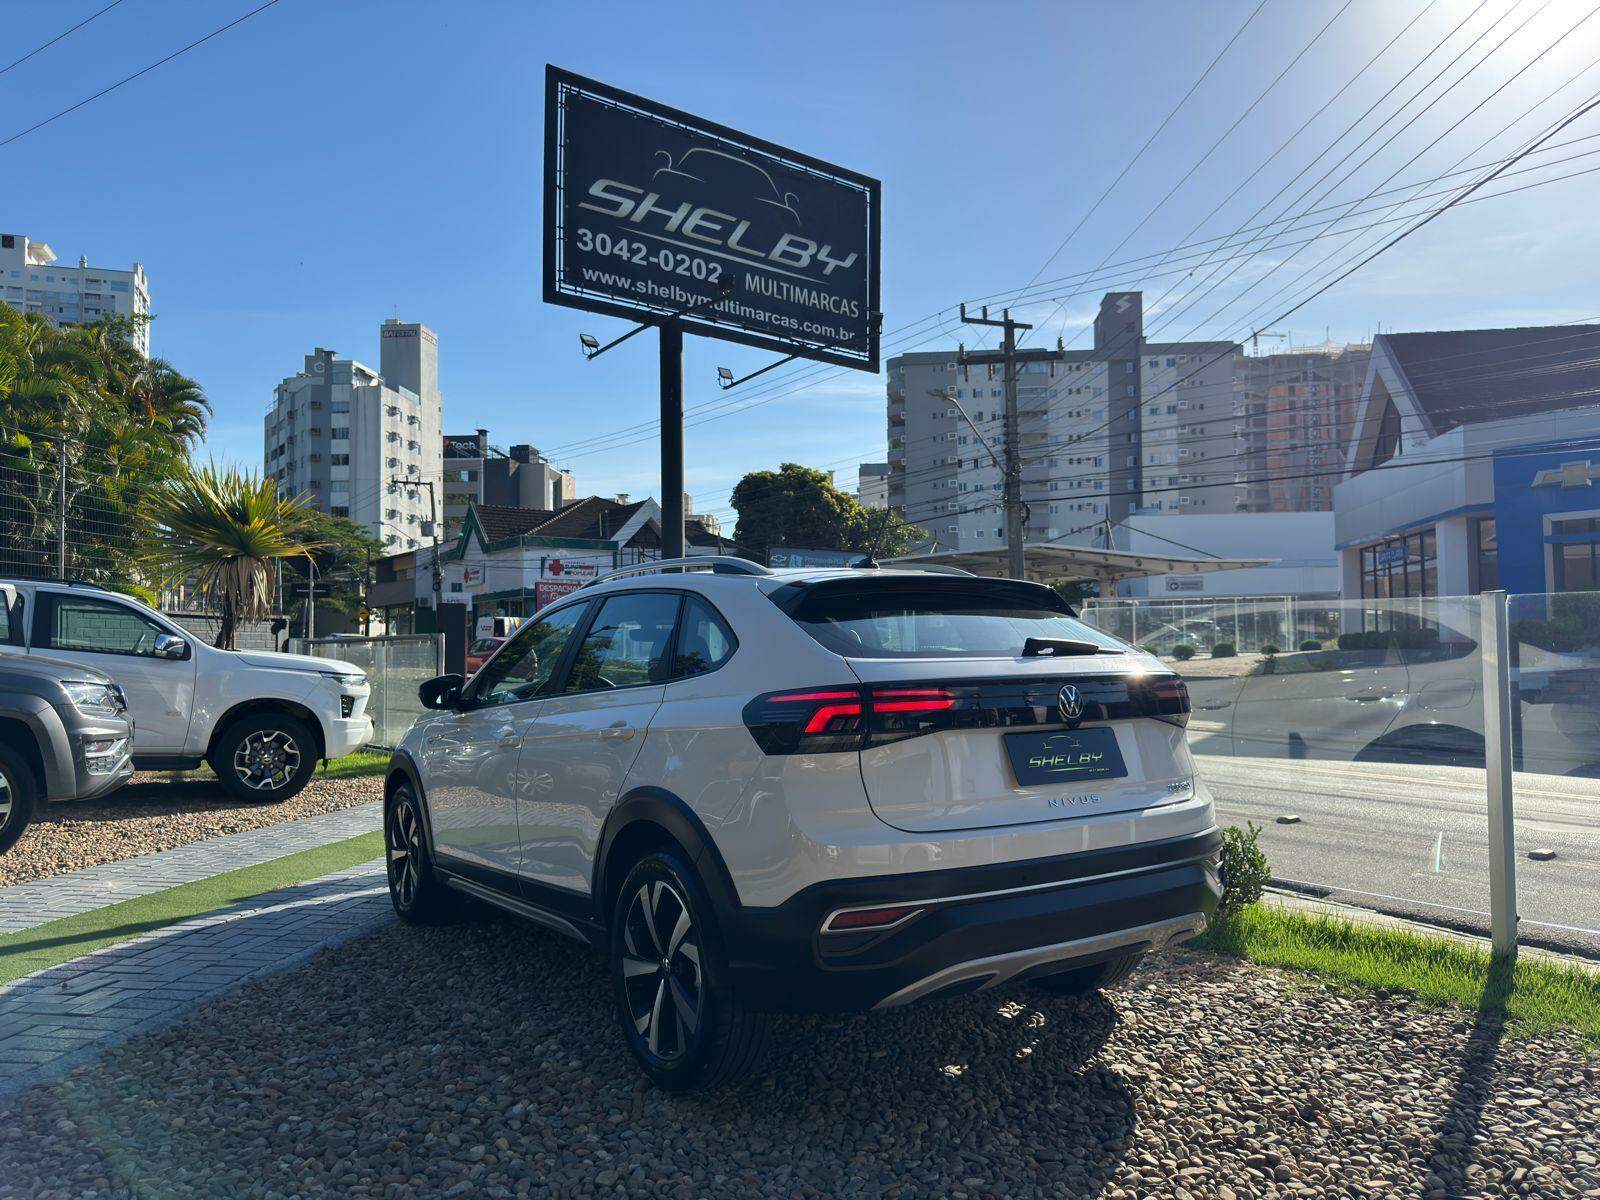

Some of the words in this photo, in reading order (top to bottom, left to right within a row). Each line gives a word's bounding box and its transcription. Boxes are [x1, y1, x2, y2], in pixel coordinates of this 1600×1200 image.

[577, 178, 859, 276] SHELBY
[576, 227, 723, 284] 3042-0202
[745, 271, 860, 319] MULTIMARCAS
[1028, 751, 1103, 769] SHELBY
[1047, 793, 1102, 809] NIVUS
